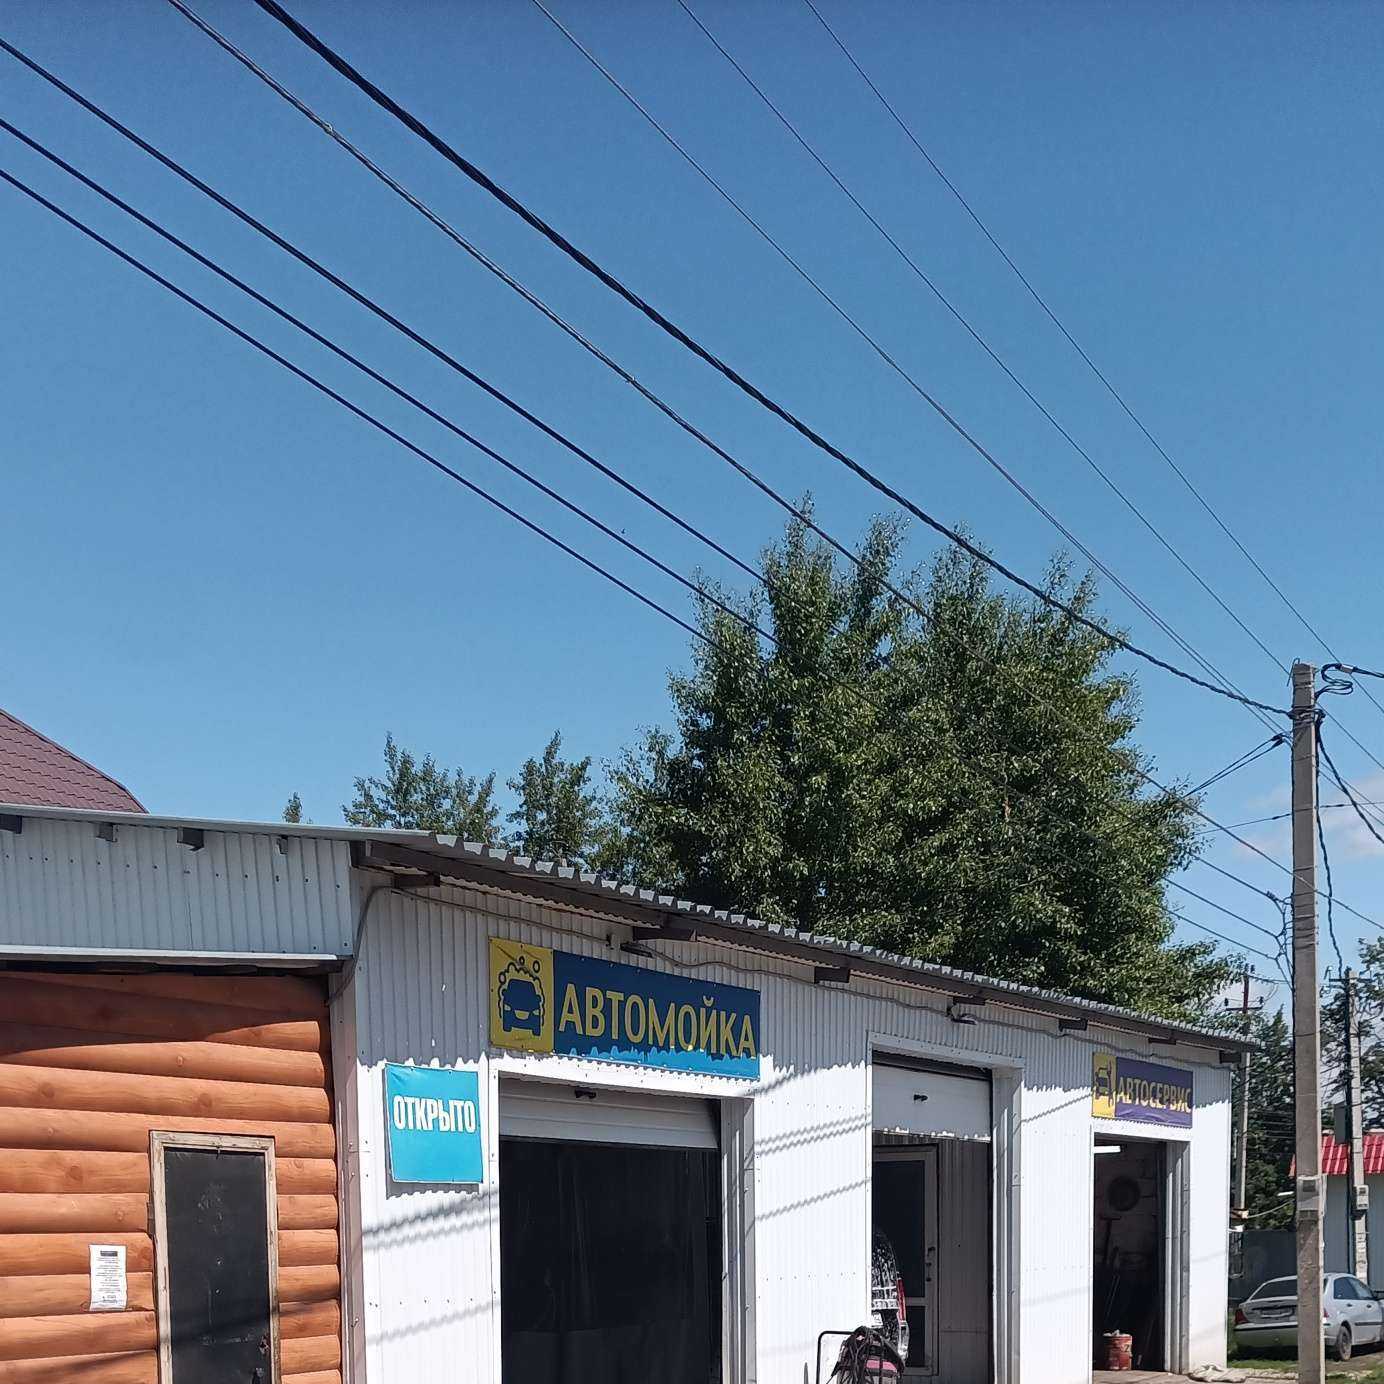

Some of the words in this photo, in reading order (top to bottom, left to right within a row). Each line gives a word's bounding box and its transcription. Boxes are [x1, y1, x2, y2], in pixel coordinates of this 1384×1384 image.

[558, 983, 756, 1060] АВТОМОЙКА
[1116, 1076, 1191, 1113] АВТОСЕРВИС
[393, 1095, 476, 1133] ОТКРЫТО
